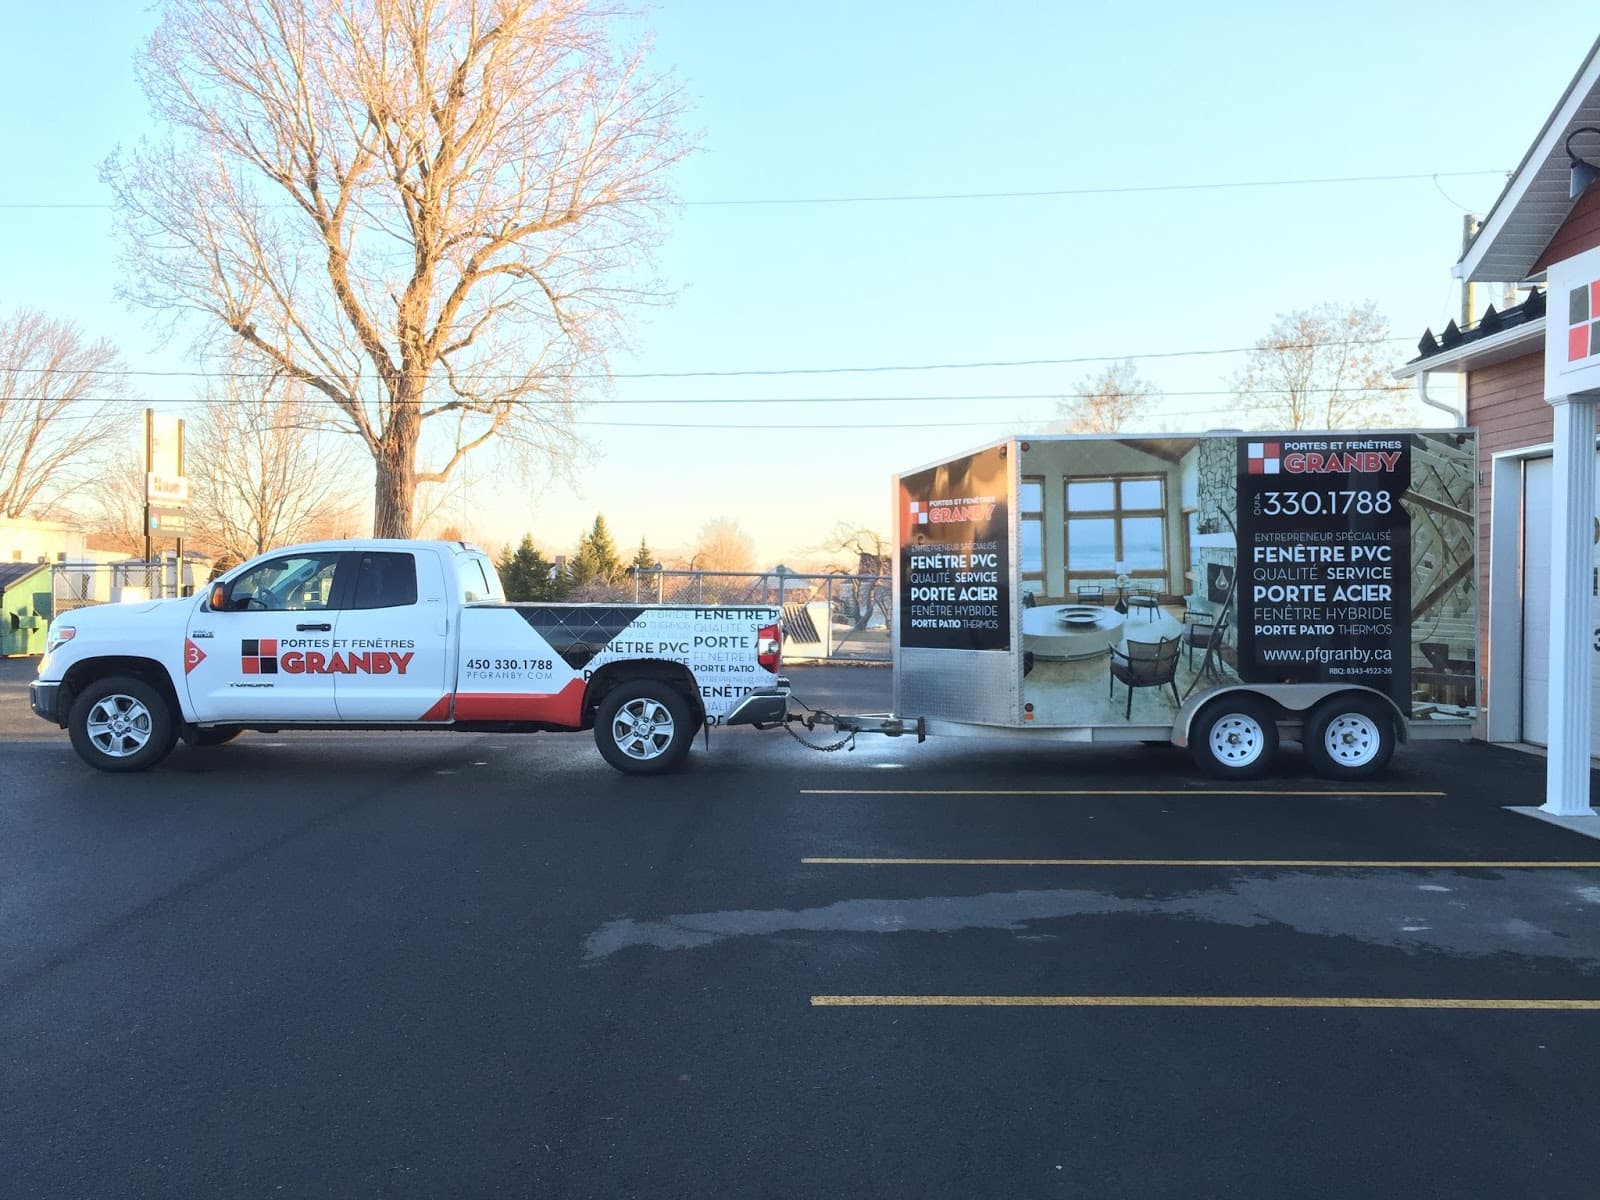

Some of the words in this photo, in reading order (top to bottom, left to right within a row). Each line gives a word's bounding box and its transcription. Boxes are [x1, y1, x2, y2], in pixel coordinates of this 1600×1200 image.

[1284, 442, 1328, 451] PORTES
[1330, 441, 1344, 450] ET
[1346, 439, 1402, 450] FENÊTRES
[1284, 451, 1402, 474] GRANBY
[1263, 490, 1392, 516] 330.1788
[929, 504, 996, 523] GRANBY
[1254, 532, 1334, 543] ENTREPRENEUR
[1335, 528, 1392, 542] SPÉCIALISÉ
[911, 543, 960, 553] ENTREPRENEUR
[1254, 543, 1346, 564] FENÊTRE
[1351, 545, 1392, 563] PVC
[911, 553, 967, 569] FENÊTRE
[970, 553, 998, 568] PVC
[911, 569, 951, 584] QUALITÉ
[954, 571, 998, 583] SERVICE
[1253, 563, 1319, 582] QUALITÉ
[1326, 566, 1392, 580] SERVICE
[911, 587, 955, 602] PORTE
[958, 586, 998, 601] ACIER
[1253, 584, 1326, 603] PORTE
[1332, 584, 1392, 602] ACIER
[911, 603, 952, 617] FENÊTRE
[955, 605, 998, 617] HYBRIDE
[1254, 604, 1321, 621] FENÊTRE
[1326, 606, 1392, 620] HYBRIDE
[911, 619, 937, 629] PORTE
[939, 619, 961, 629] PATIO
[963, 619, 998, 629] THERMOS
[1254, 624, 1297, 636] PORTE
[1300, 624, 1335, 636] PATIO
[1338, 623, 1392, 636] THERMOS
[281, 638, 330, 649] PORTES
[333, 638, 348, 648] ET
[351, 636, 415, 649] FENÊTRES
[659, 641, 690, 654] PVC
[694, 636, 749, 648] PORTE
[188, 647, 199, 664] 3
[281, 650, 415, 675] GRANBY
[1263, 646, 1392, 664] www.pfgranby.ca
[467, 659, 490, 670] 450
[494, 659, 553, 670] 330.1788
[694, 664, 726, 673] PORTE
[728, 664, 755, 673] PATIO
[467, 671, 553, 680] PFGRANBY.COM
